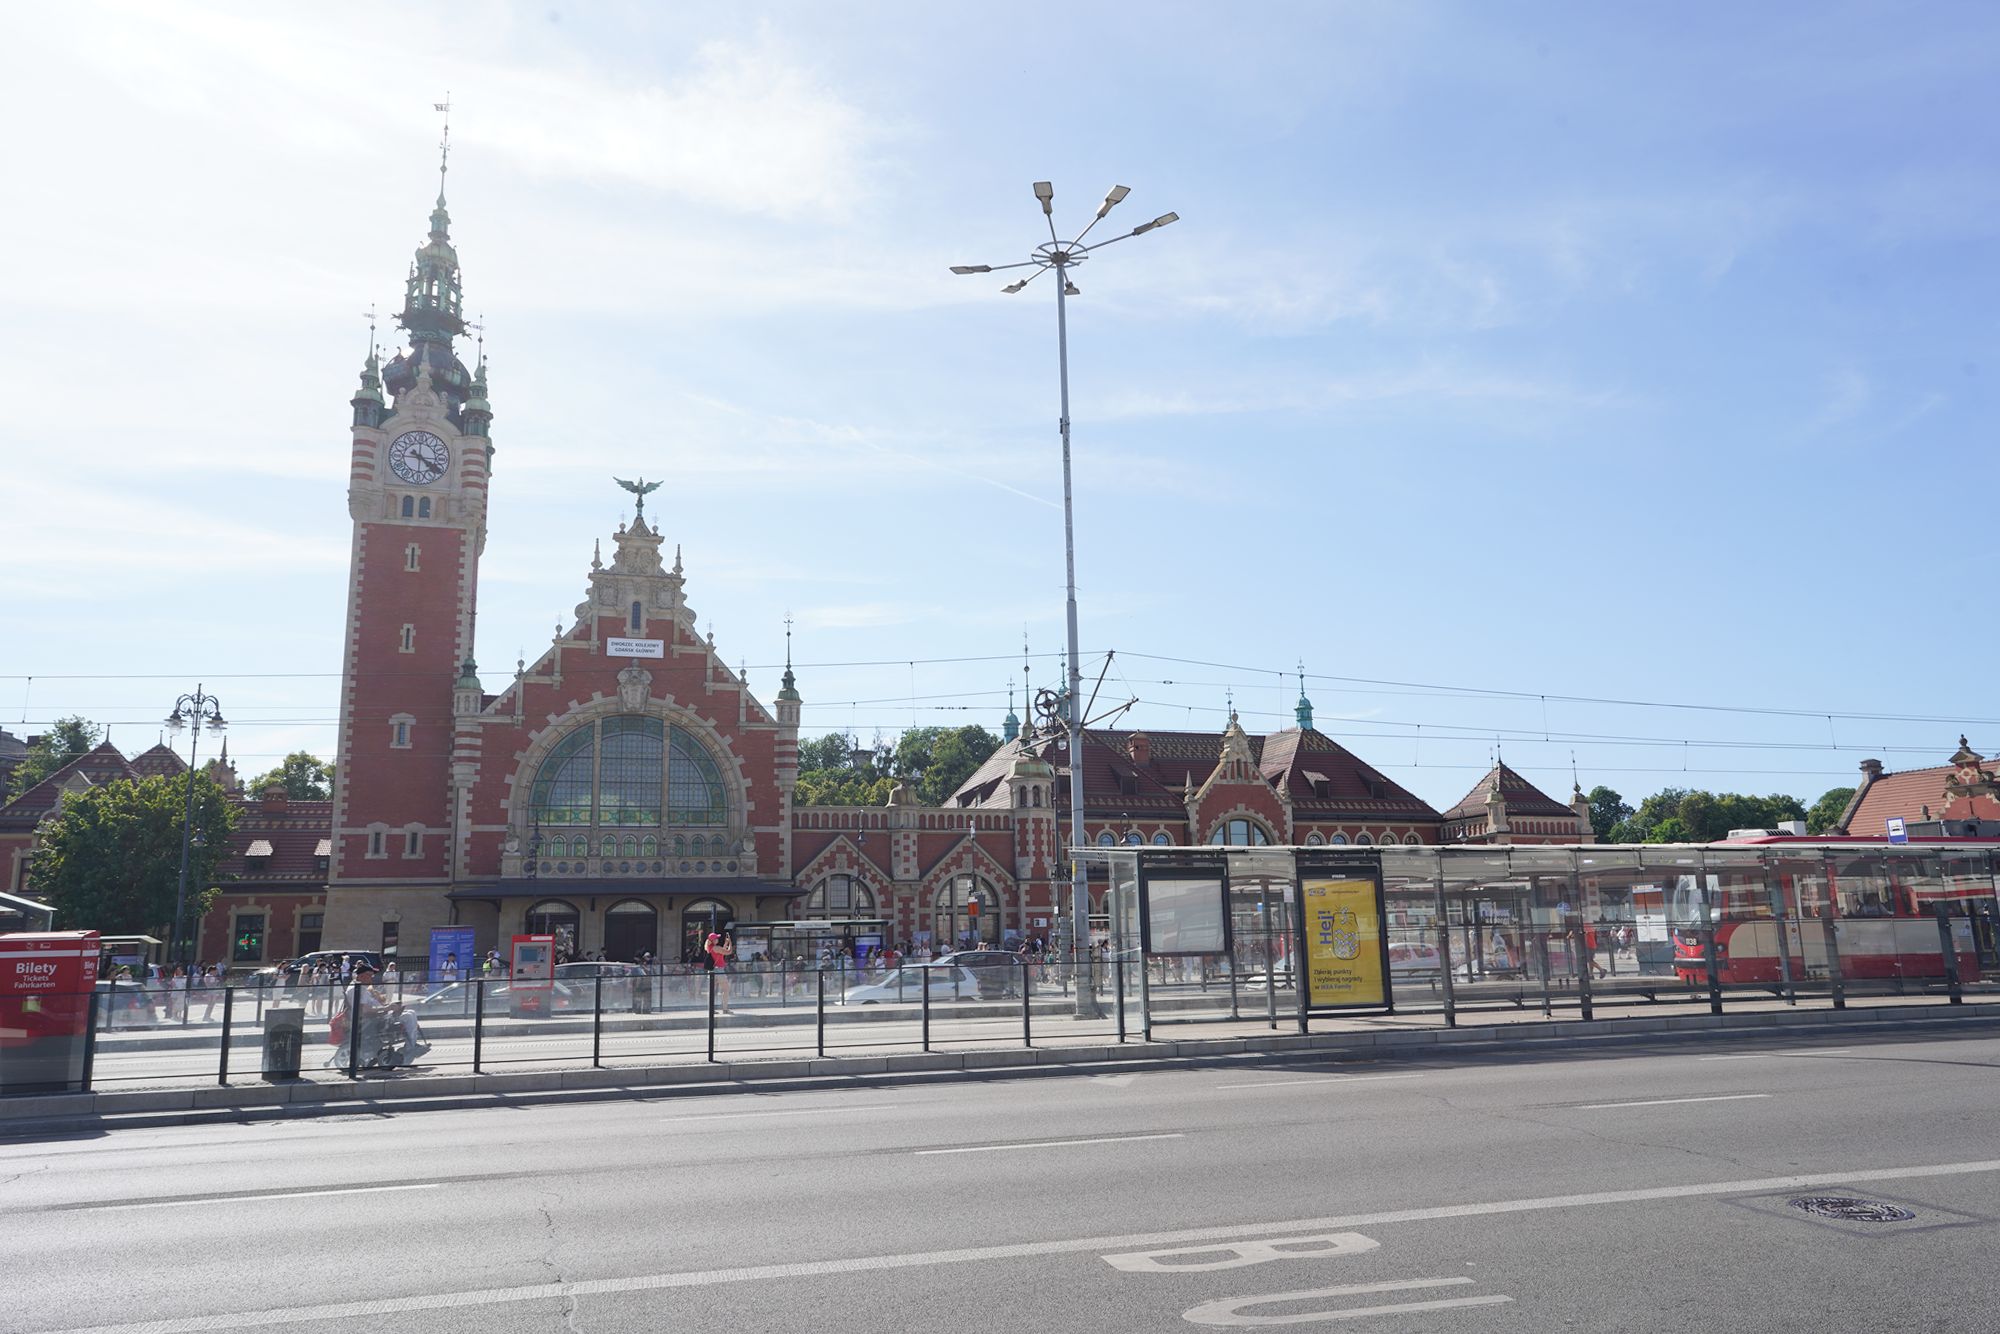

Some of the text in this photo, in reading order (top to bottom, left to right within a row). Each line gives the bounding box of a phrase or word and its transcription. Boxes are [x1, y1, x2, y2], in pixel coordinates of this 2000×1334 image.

[1318, 910, 1334, 944] Hej!
[16, 962, 57, 976] Bilety
[14, 981, 56, 989] Fahrkarten
